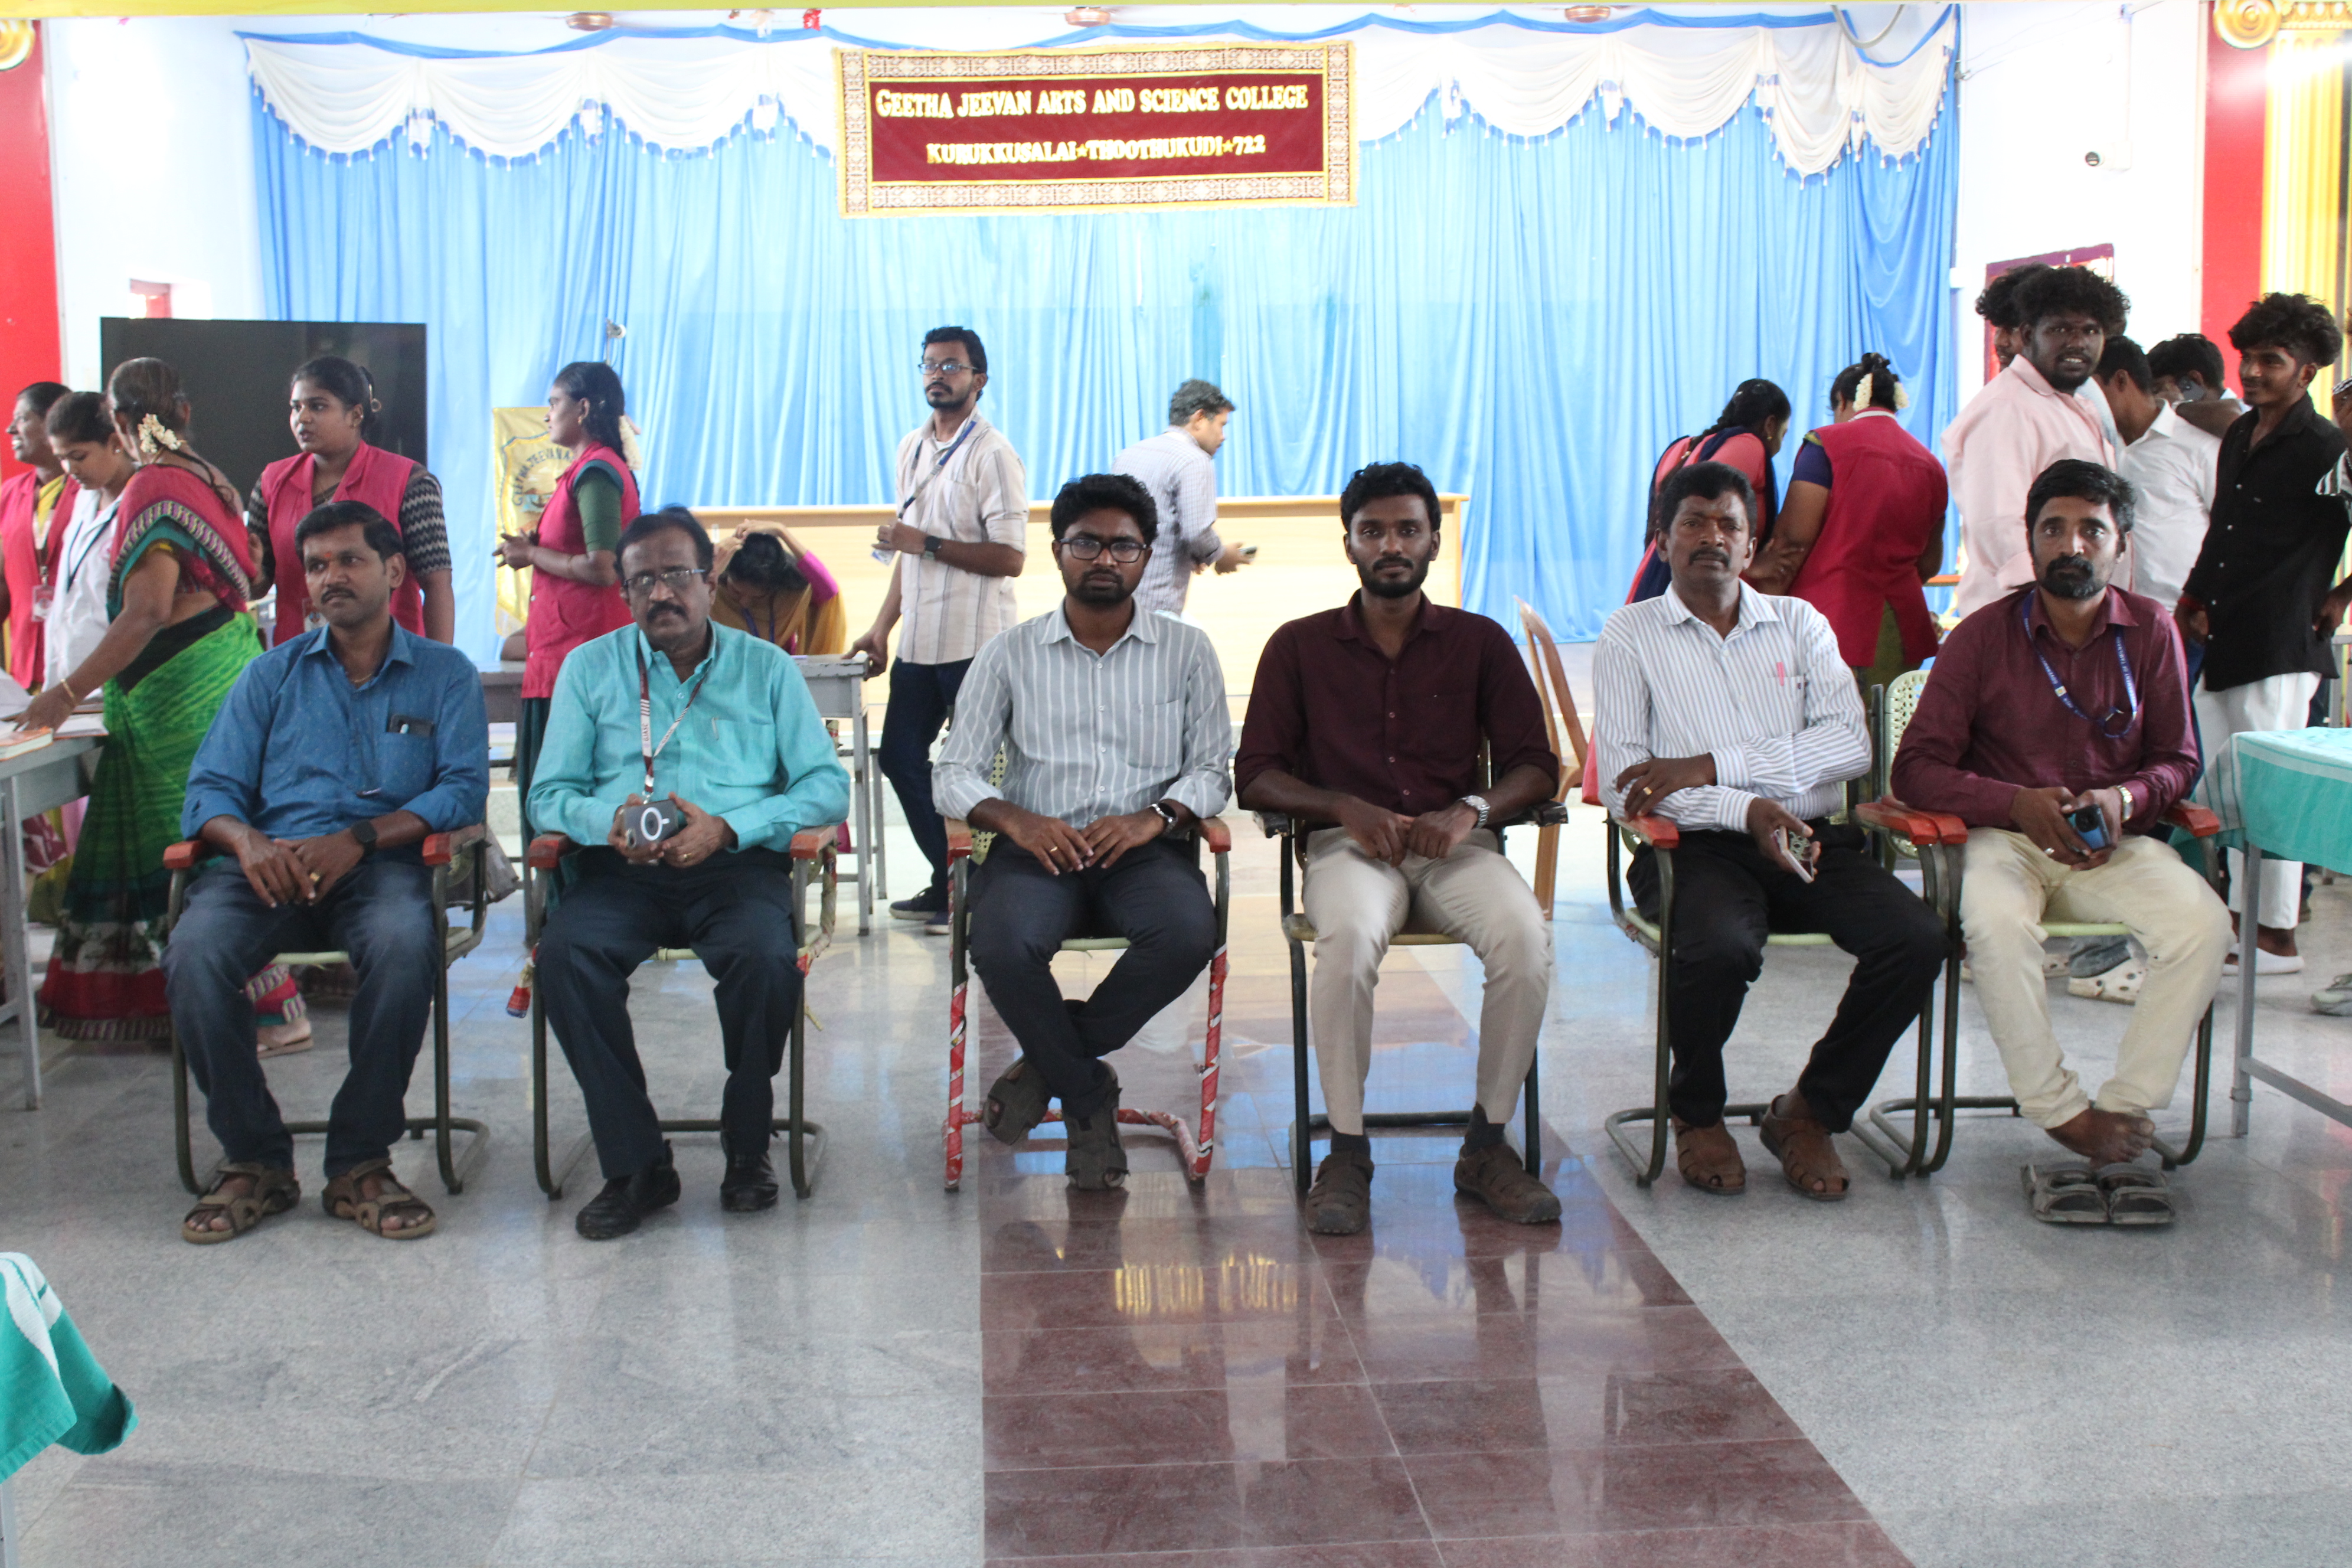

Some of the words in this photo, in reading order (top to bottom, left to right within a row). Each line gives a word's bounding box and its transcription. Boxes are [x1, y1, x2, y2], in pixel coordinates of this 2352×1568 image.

[876, 89, 954, 119] GEETHA
[956, 90, 1032, 117] JEEVAN
[1035, 89, 1087, 115] ARTS
[1092, 88, 1136, 113] AND
[1139, 86, 1220, 113] SCIENCE
[1225, 84, 1309, 110] COLLEGE
